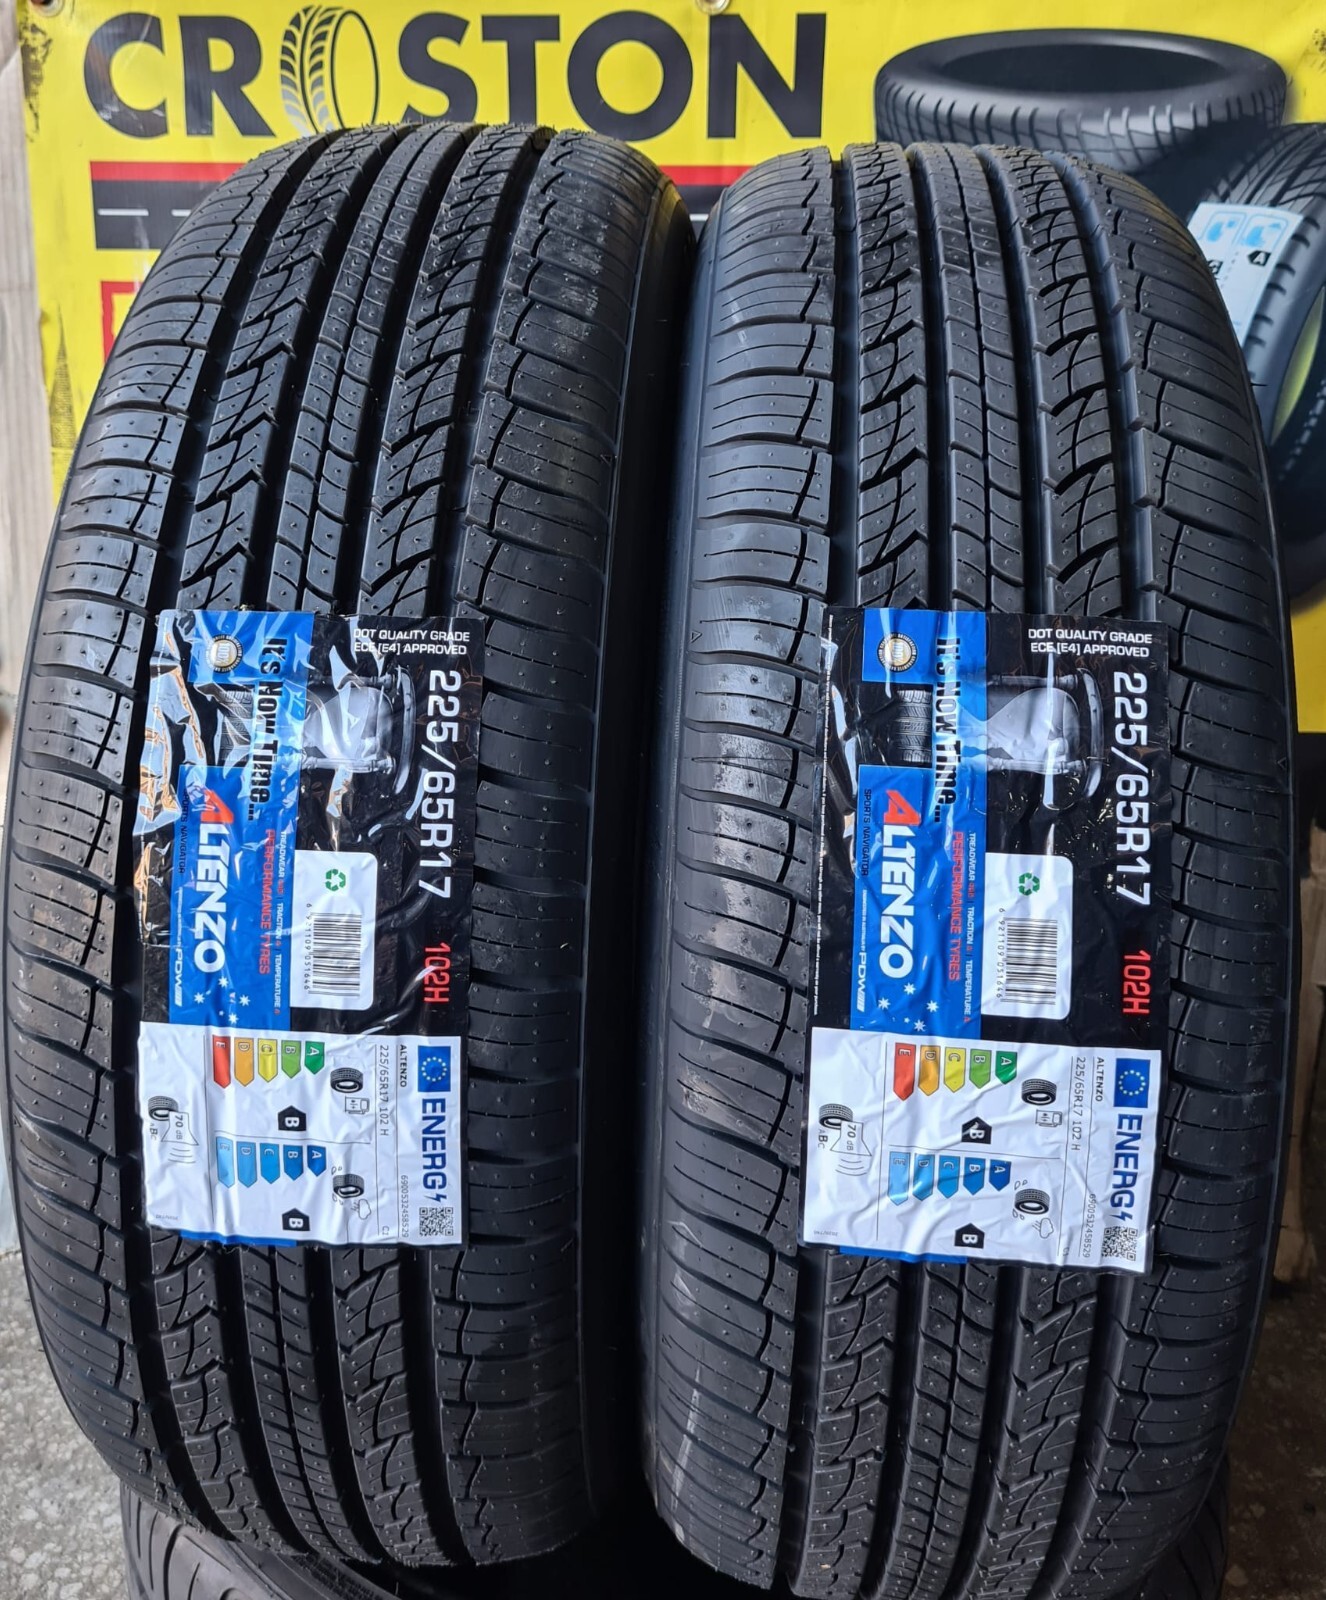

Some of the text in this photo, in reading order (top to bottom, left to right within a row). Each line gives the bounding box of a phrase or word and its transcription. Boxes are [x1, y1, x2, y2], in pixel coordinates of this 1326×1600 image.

[354, 628, 470, 642] DOT QUALITY GRADE
[354, 642, 467, 655] ECE [E4] APPROVED
[1029, 629, 1152, 643] DOT QUALITY GRADE
[1031, 642, 1149, 657] ECE [E4] APPROVED
[934, 639, 961, 823] It's Now Time...
[419, 670, 461, 898] 225/65R17
[1110, 672, 1151, 905] 225/65R17
[179, 825, 187, 873] NAVIGATOR
[278, 831, 286, 877] TREADWEAR
[861, 826, 870, 876] NAVIGATOR
[968, 833, 976, 880] TREADWEAR
[192, 788, 233, 973] ALTENZO
[259, 829, 276, 974] PERFORMANCE TYRES
[881, 790, 921, 978] ALTENZO
[949, 832, 964, 980] PERFORMANCE TYRES
[174, 948, 183, 991] PDW
[274, 954, 282, 1007] TEMPERATURE
[423, 942, 450, 1002] 102H
[858, 952, 867, 996] PDW
[964, 960, 972, 1015] TEMPERATURE
[1123, 950, 1151, 1013] 102H
[239, 1043, 249, 1051] D
[261, 1044, 272, 1052] C
[309, 1046, 319, 1055] A
[925, 1051, 936, 1059] D
[949, 1053, 960, 1061] C
[1001, 1057, 1011, 1065] A
[379, 1045, 390, 1102] 225/65R17
[1073, 1057, 1086, 1116] 225/65R17
[175, 1115, 183, 1140] 70 dB
[285, 1116, 300, 1127] B
[380, 1107, 390, 1124] 102
[970, 1129, 984, 1139] B
[1072, 1121, 1081, 1140] 102
[312, 1150, 322, 1158] A
[422, 1099, 447, 1189] ENERG
[847, 1125, 856, 1150] 70 dB
[1083, 1057, 1104, 1258] ALTENZO 6900532458529
[969, 1164, 980, 1172] B
[1111, 1114, 1143, 1208] ENERG
[290, 1217, 303, 1228] B
[962, 1234, 977, 1243] B
